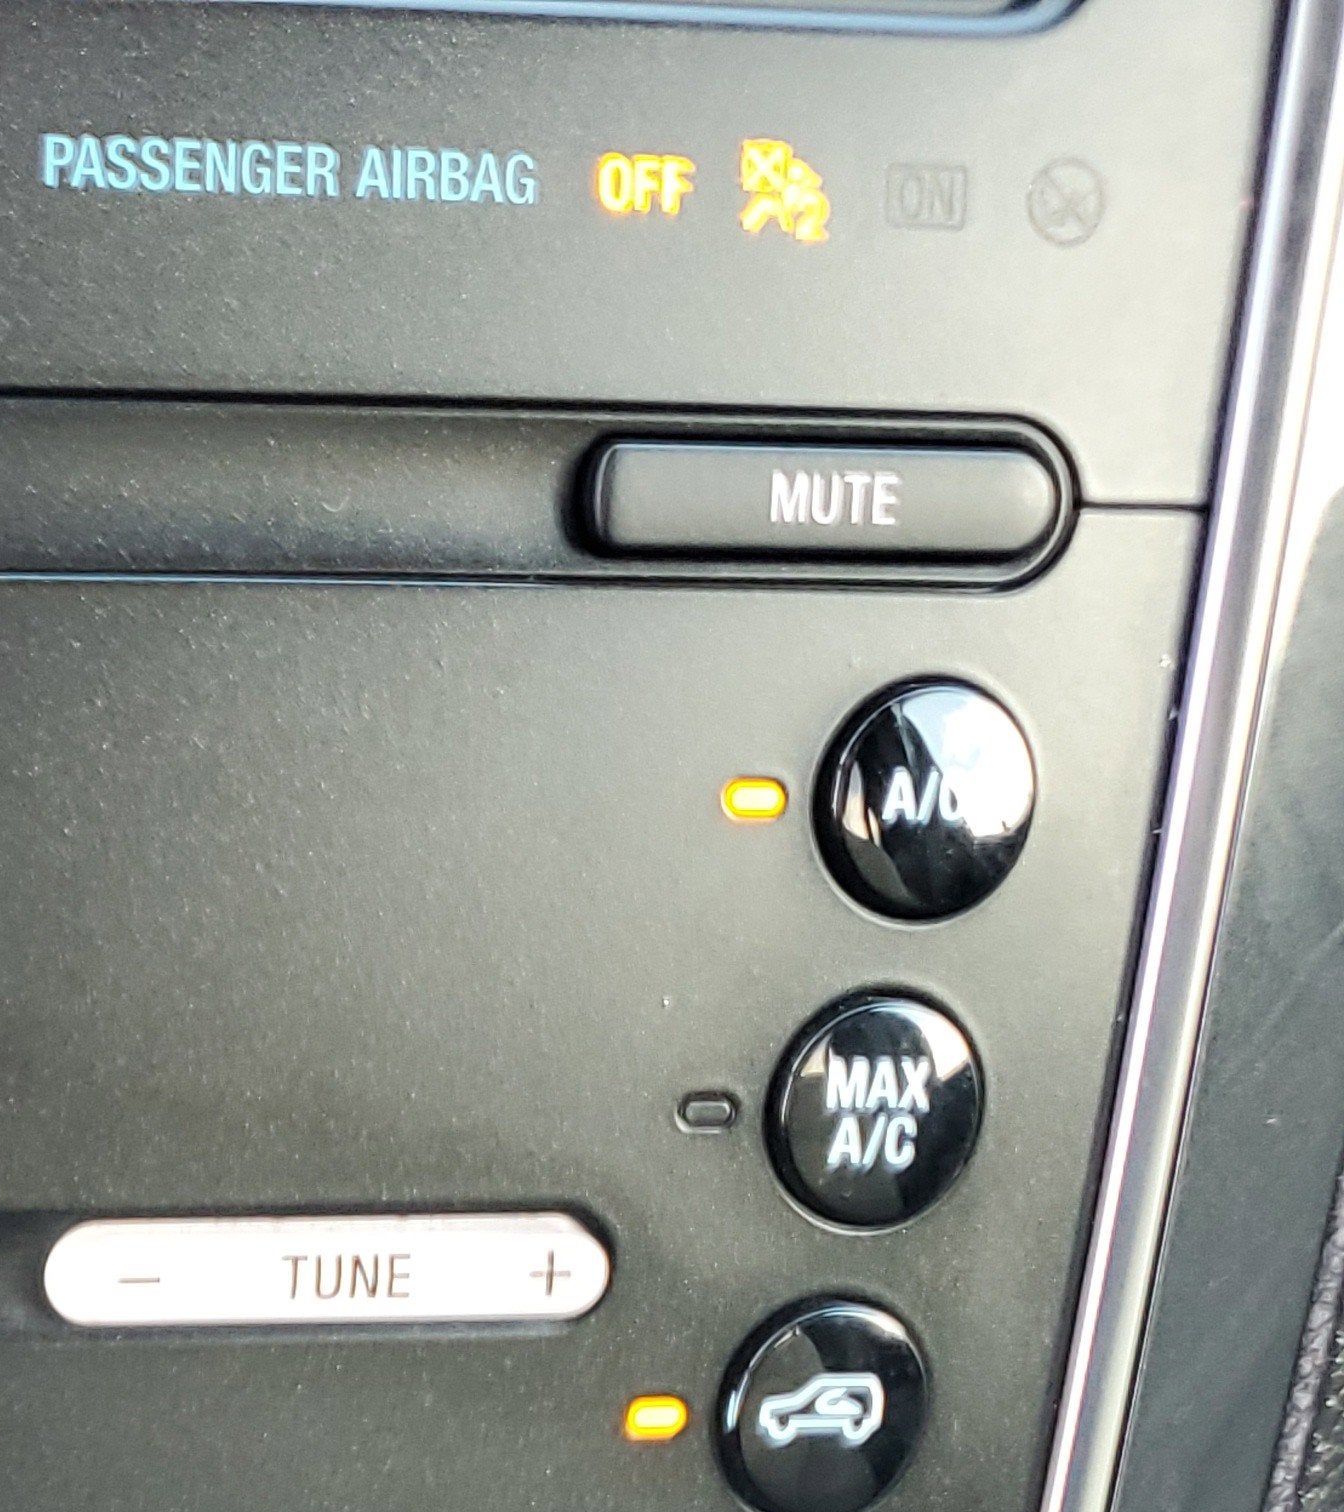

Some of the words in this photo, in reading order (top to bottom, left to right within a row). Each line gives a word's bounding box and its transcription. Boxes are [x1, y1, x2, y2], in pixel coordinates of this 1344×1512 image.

[42, 133, 339, 196] PASSENGER
[356, 146, 538, 204] AIRBAG
[597, 152, 696, 214] OFF
[901, 173, 955, 222] ON
[769, 469, 902, 526] MUTE
[825, 1055, 931, 1112] MAX
[825, 1114, 918, 1172] A/C
[282, 1253, 411, 1299] TUNE
